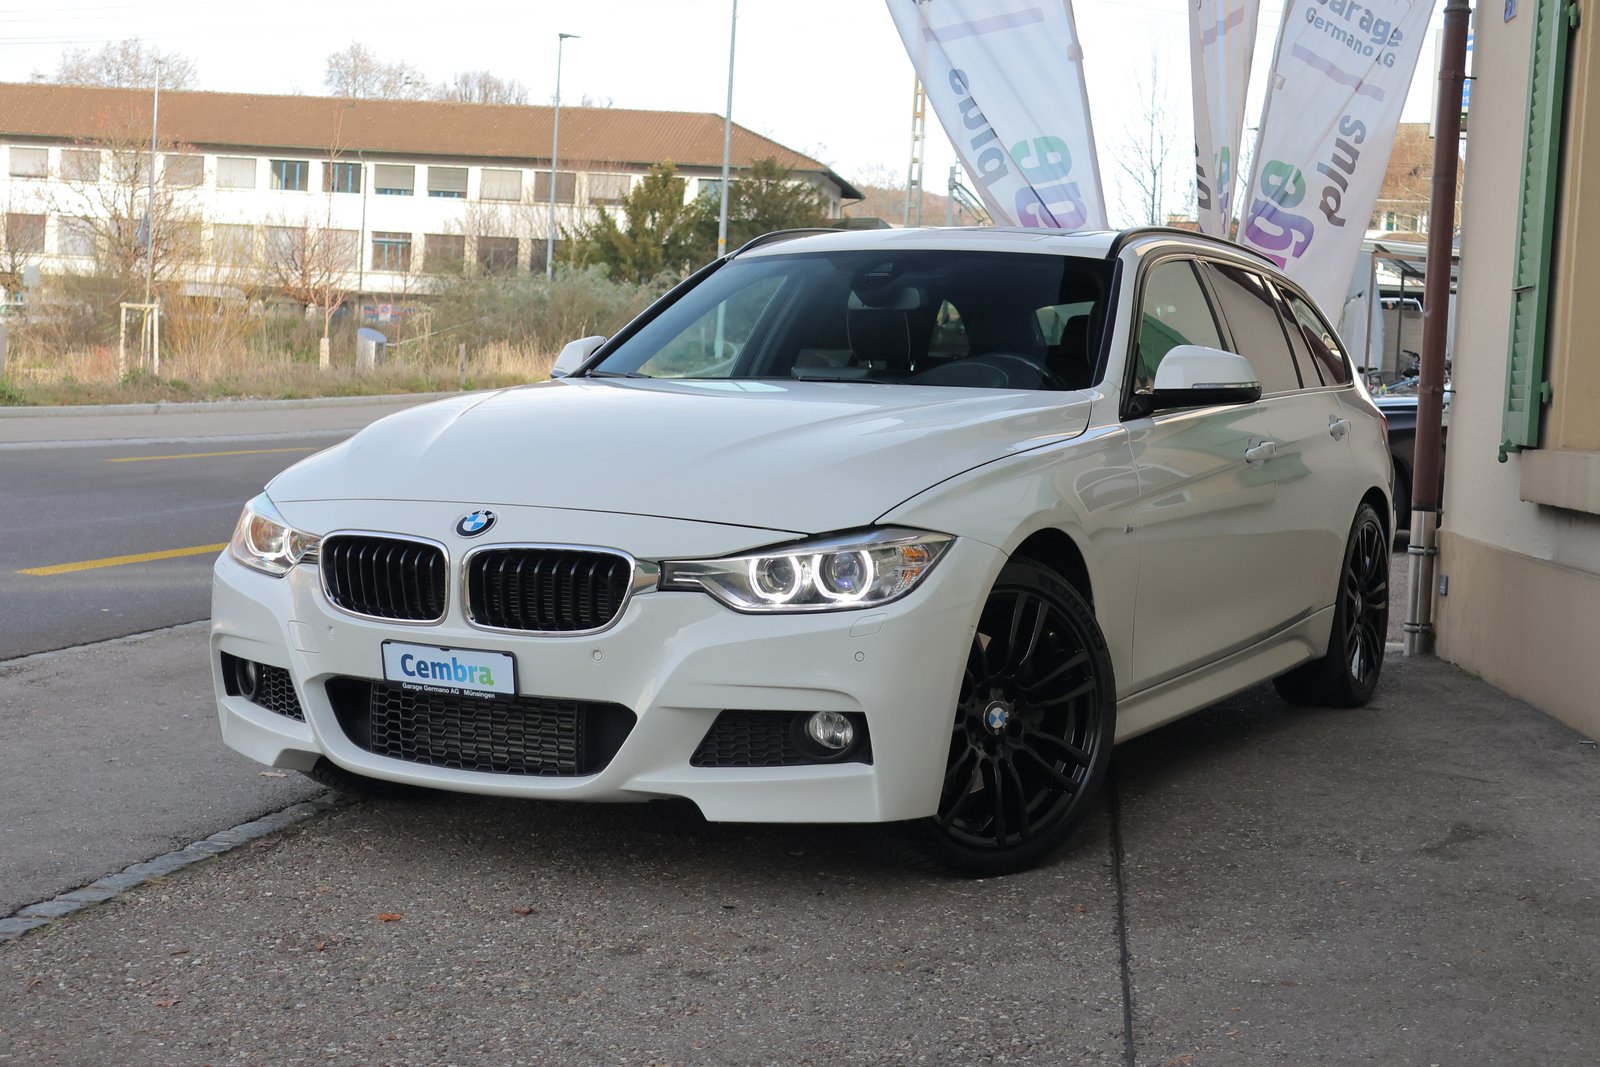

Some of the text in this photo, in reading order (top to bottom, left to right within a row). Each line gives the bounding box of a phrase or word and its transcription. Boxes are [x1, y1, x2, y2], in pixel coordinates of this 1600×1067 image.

[1305, 7, 1374, 56] Germano
[1316, 0, 1403, 47] arage
[1316, 114, 1367, 227] plus
[401, 653, 495, 686] Cembra
[402, 682, 423, 692] Garage
[423, 684, 450, 694] Germano
[463, 689, 496, 699] Münsingen
